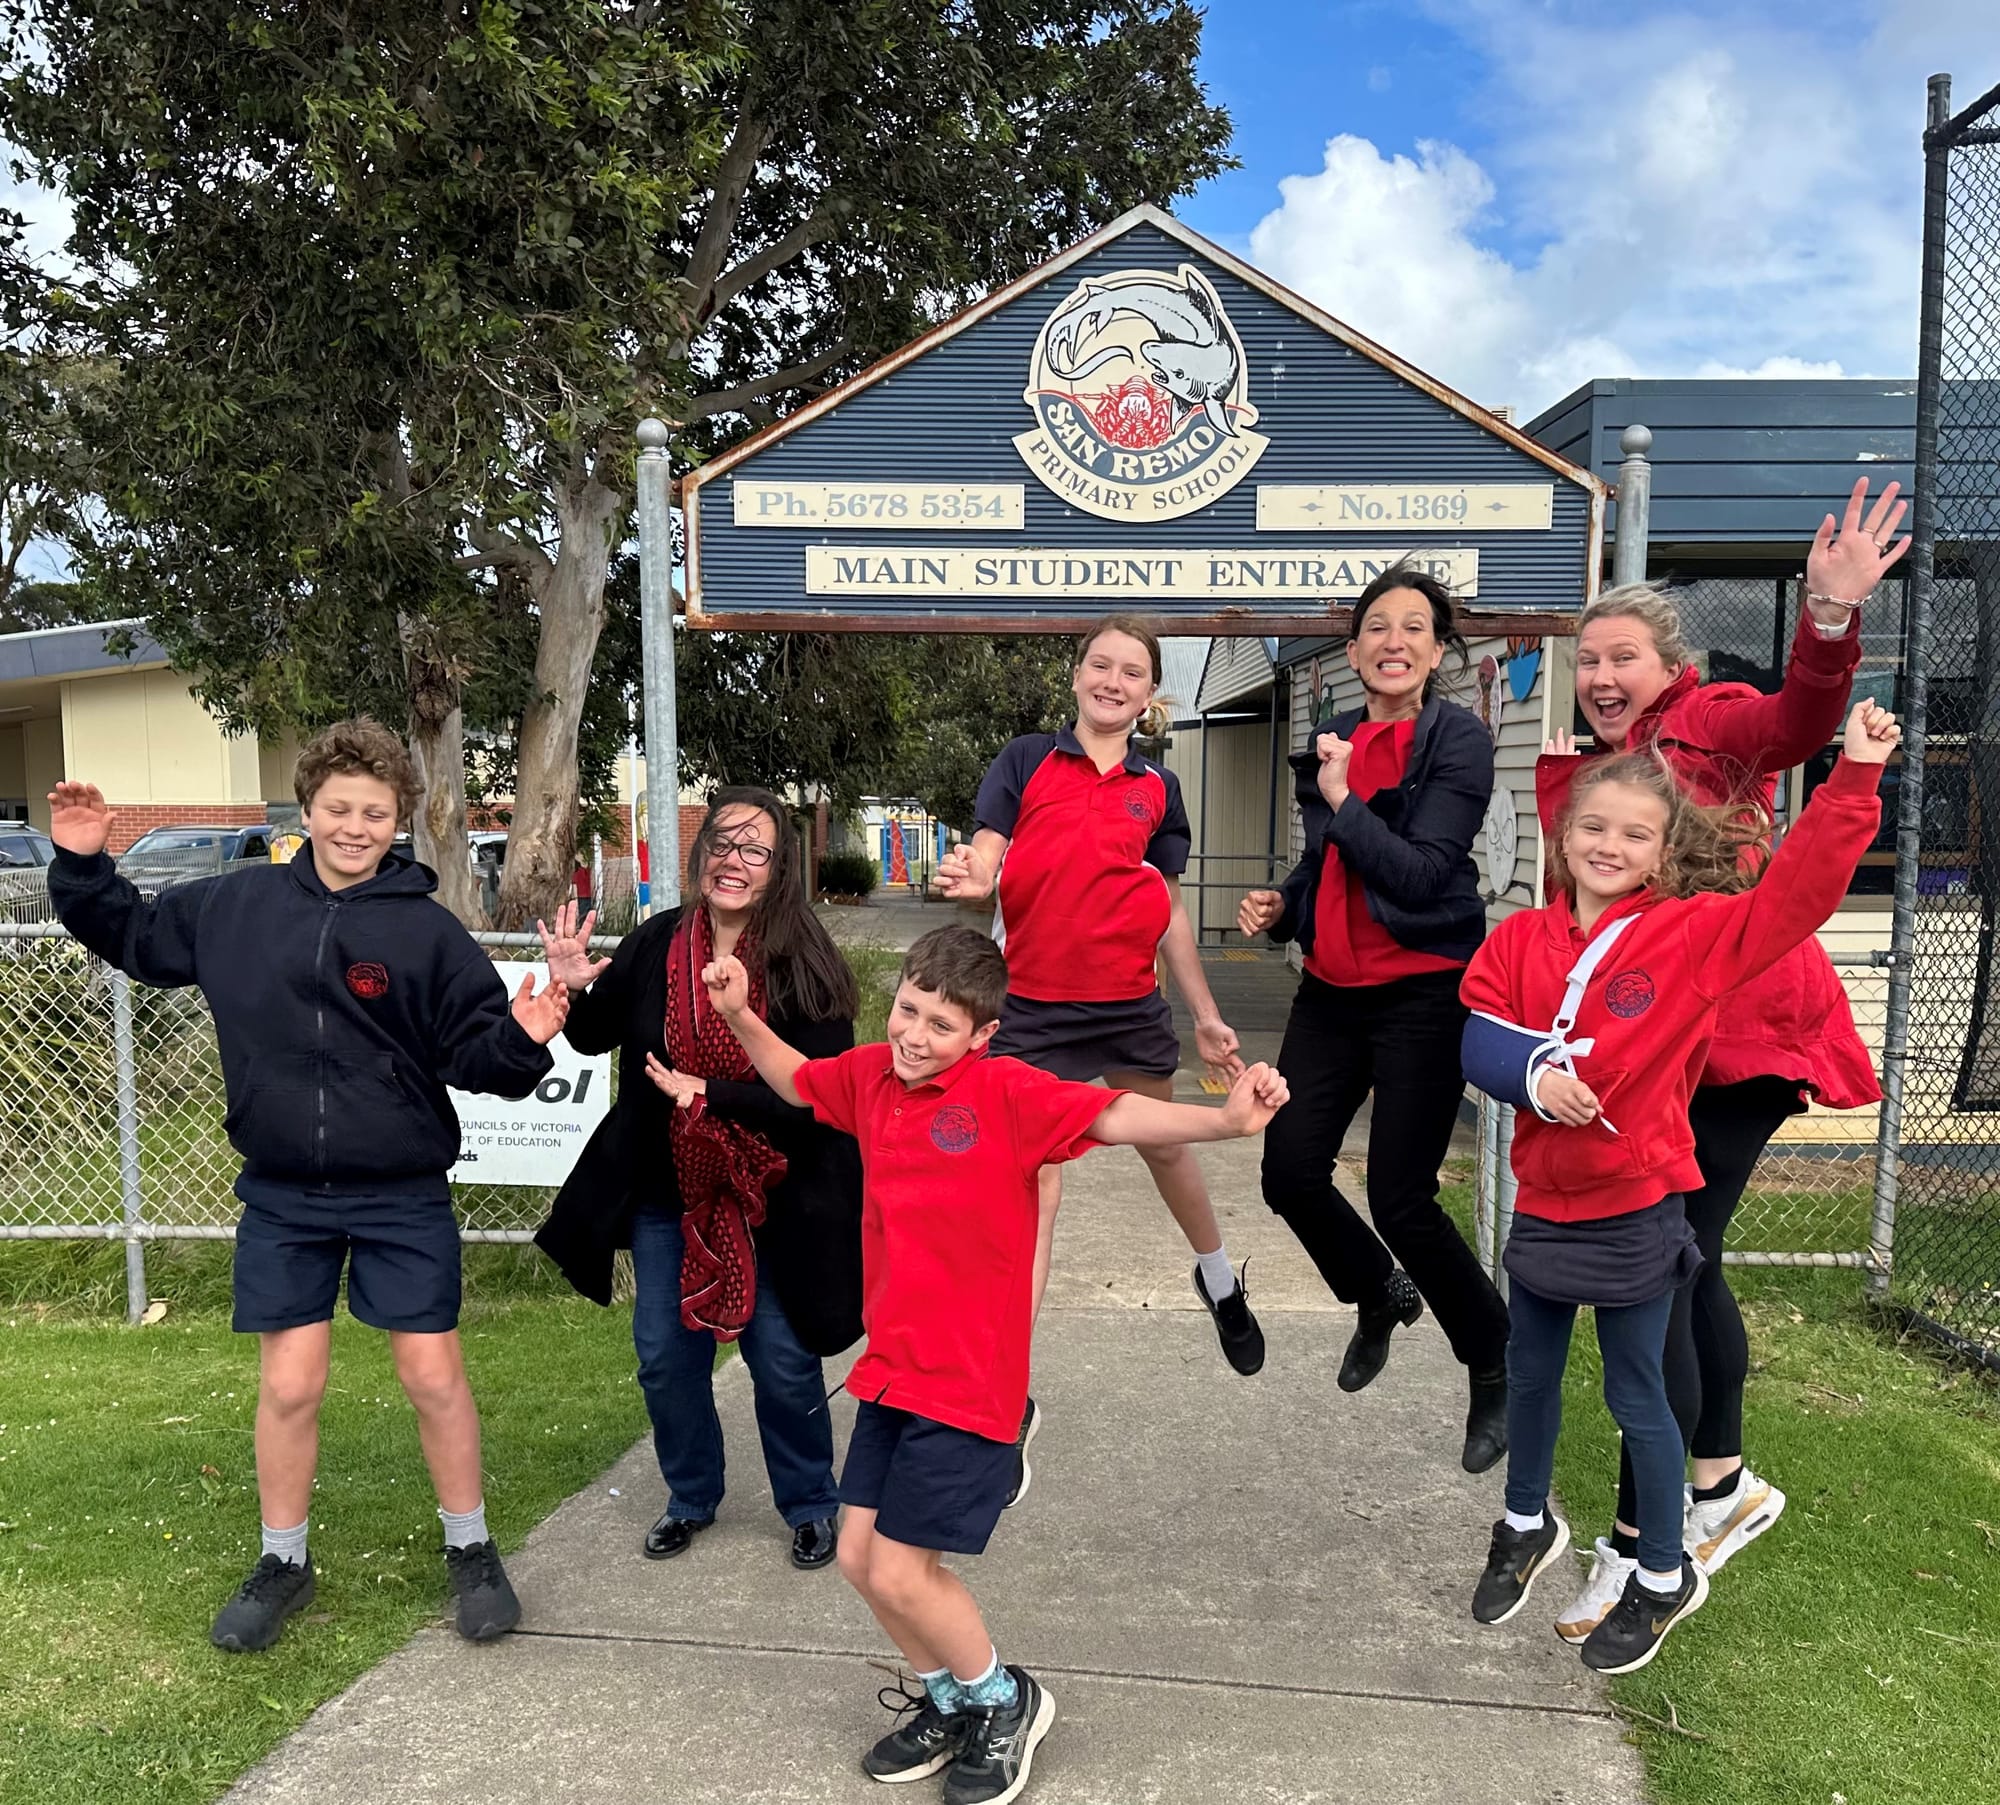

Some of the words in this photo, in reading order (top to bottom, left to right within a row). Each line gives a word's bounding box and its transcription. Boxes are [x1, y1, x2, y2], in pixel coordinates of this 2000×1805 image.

[1047, 401, 1104, 468] SAN
[1109, 426, 1216, 480] REMO
[1029, 437, 1139, 511] PRIMARY
[1153, 444, 1250, 510] SCHOOL
[756, 491, 817, 517] Ph.
[826, 493, 909, 518] 5678
[920, 494, 1005, 519] 5354
[833, 557, 950, 585] MAIN
[975, 558, 1183, 587] STUDENT
[459, 1120, 508, 1131] OUNCILS
[511, 1121, 527, 1131] OF
[530, 1123, 582, 1133] VICTORIA
[478, 1136, 493, 1145] OF
[497, 1136, 562, 1147] EDUCATION
